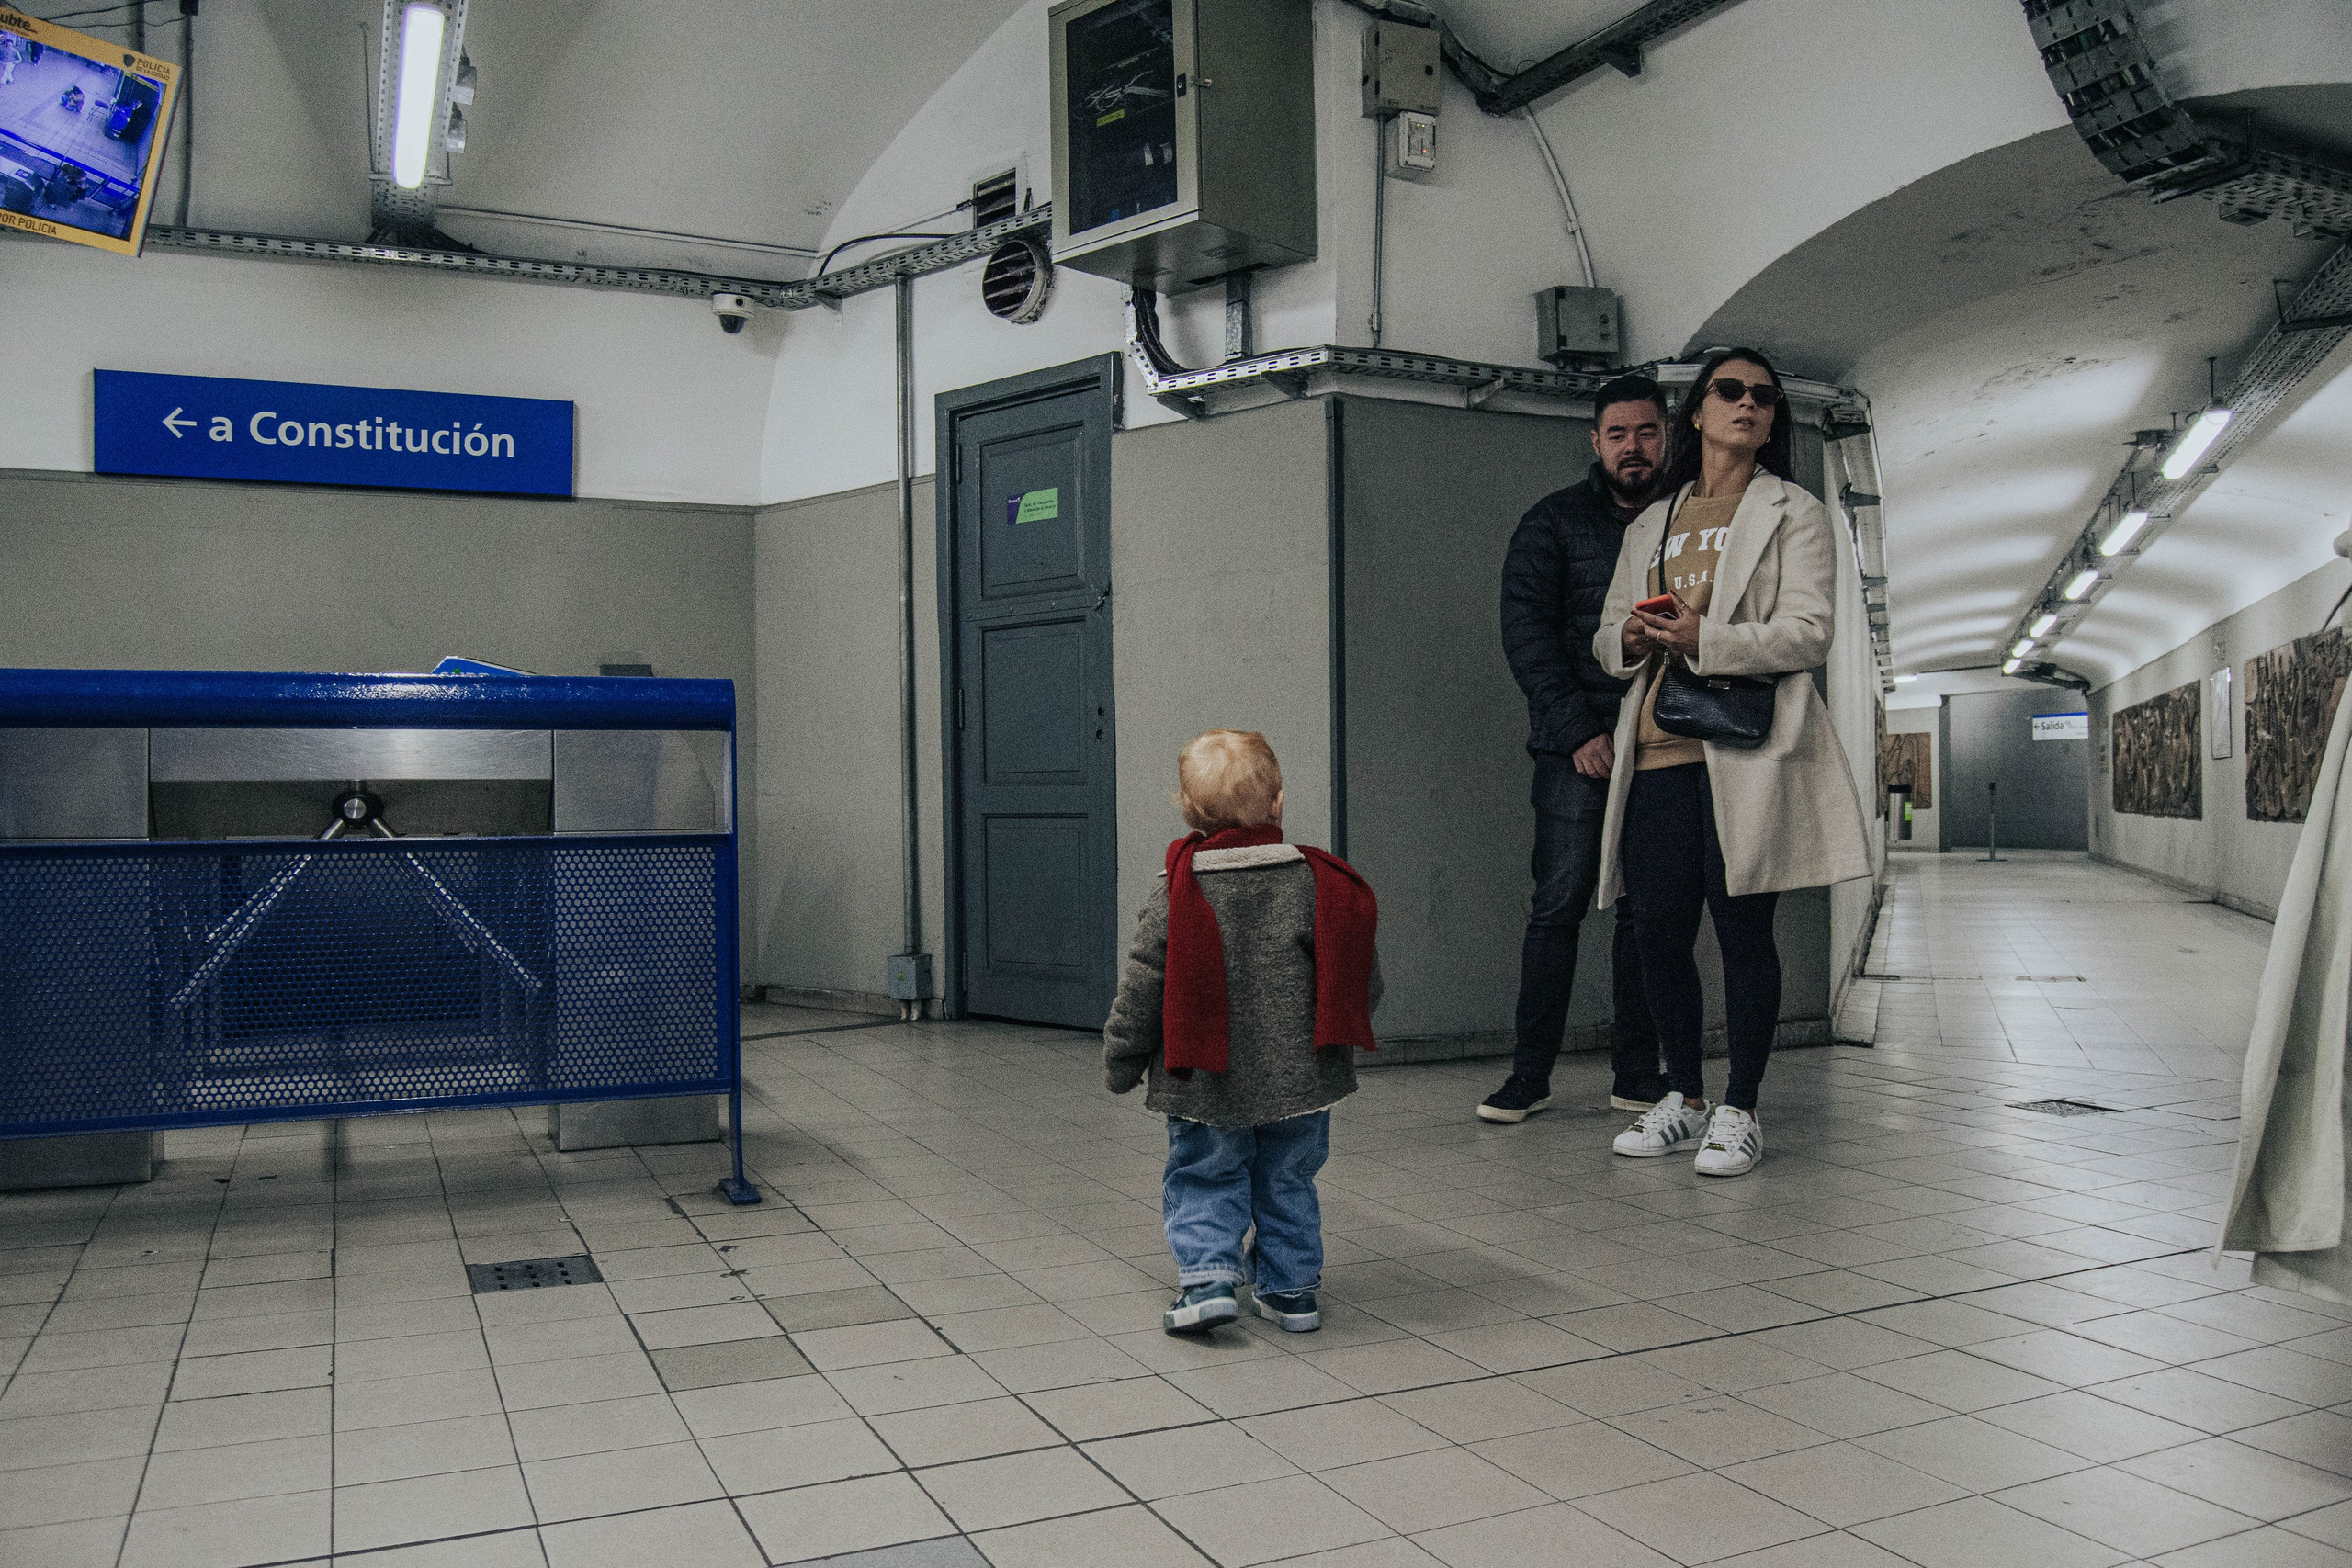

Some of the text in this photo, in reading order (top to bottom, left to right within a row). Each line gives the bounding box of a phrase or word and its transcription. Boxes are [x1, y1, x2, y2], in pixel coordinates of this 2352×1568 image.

[138, 58, 171, 75] POLICIA
[18, 217, 57, 235] POLICIA
[209, 411, 514, 458] a Constitución
[1674, 570, 1713, 590] U.S.A.
[2041, 720, 2064, 731] Salida
